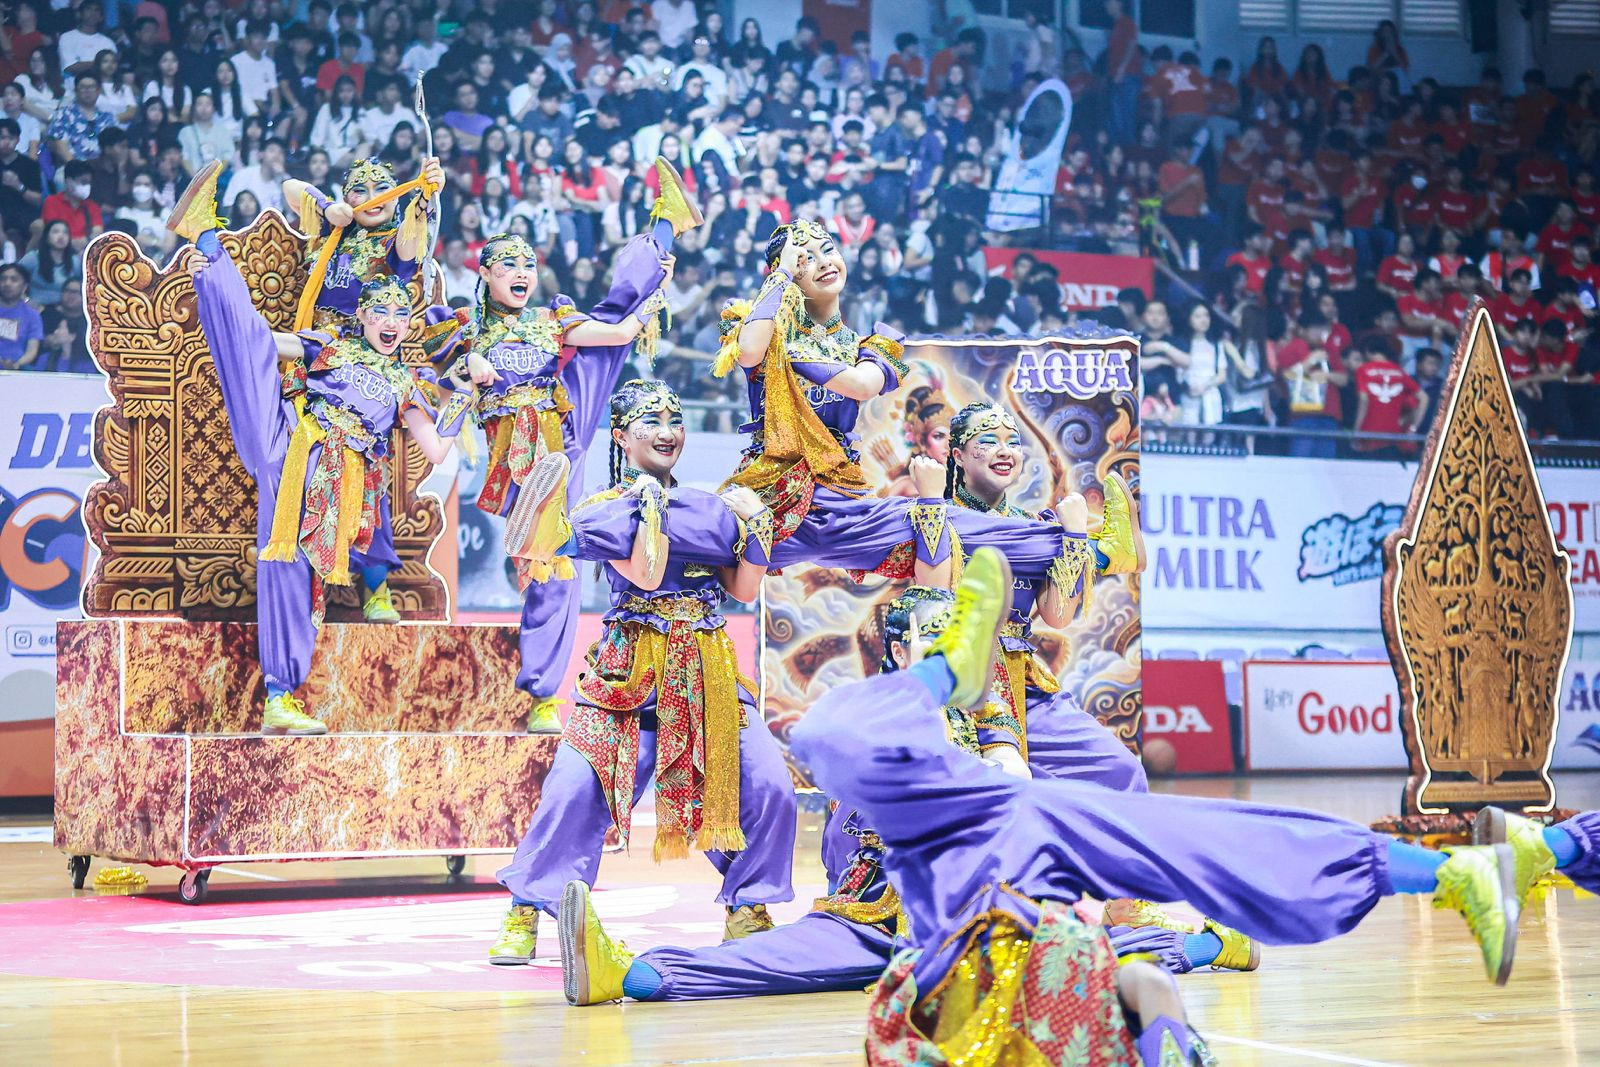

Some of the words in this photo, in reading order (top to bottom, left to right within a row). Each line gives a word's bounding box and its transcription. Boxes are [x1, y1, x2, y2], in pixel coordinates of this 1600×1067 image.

[487, 346, 547, 376] AQUA
[1010, 349, 1133, 400] AQUA
[334, 362, 394, 406] AQUA
[1140, 494, 1276, 539] ULTRA
[1154, 547, 1263, 590] MILK
[1298, 691, 1393, 735] Good
